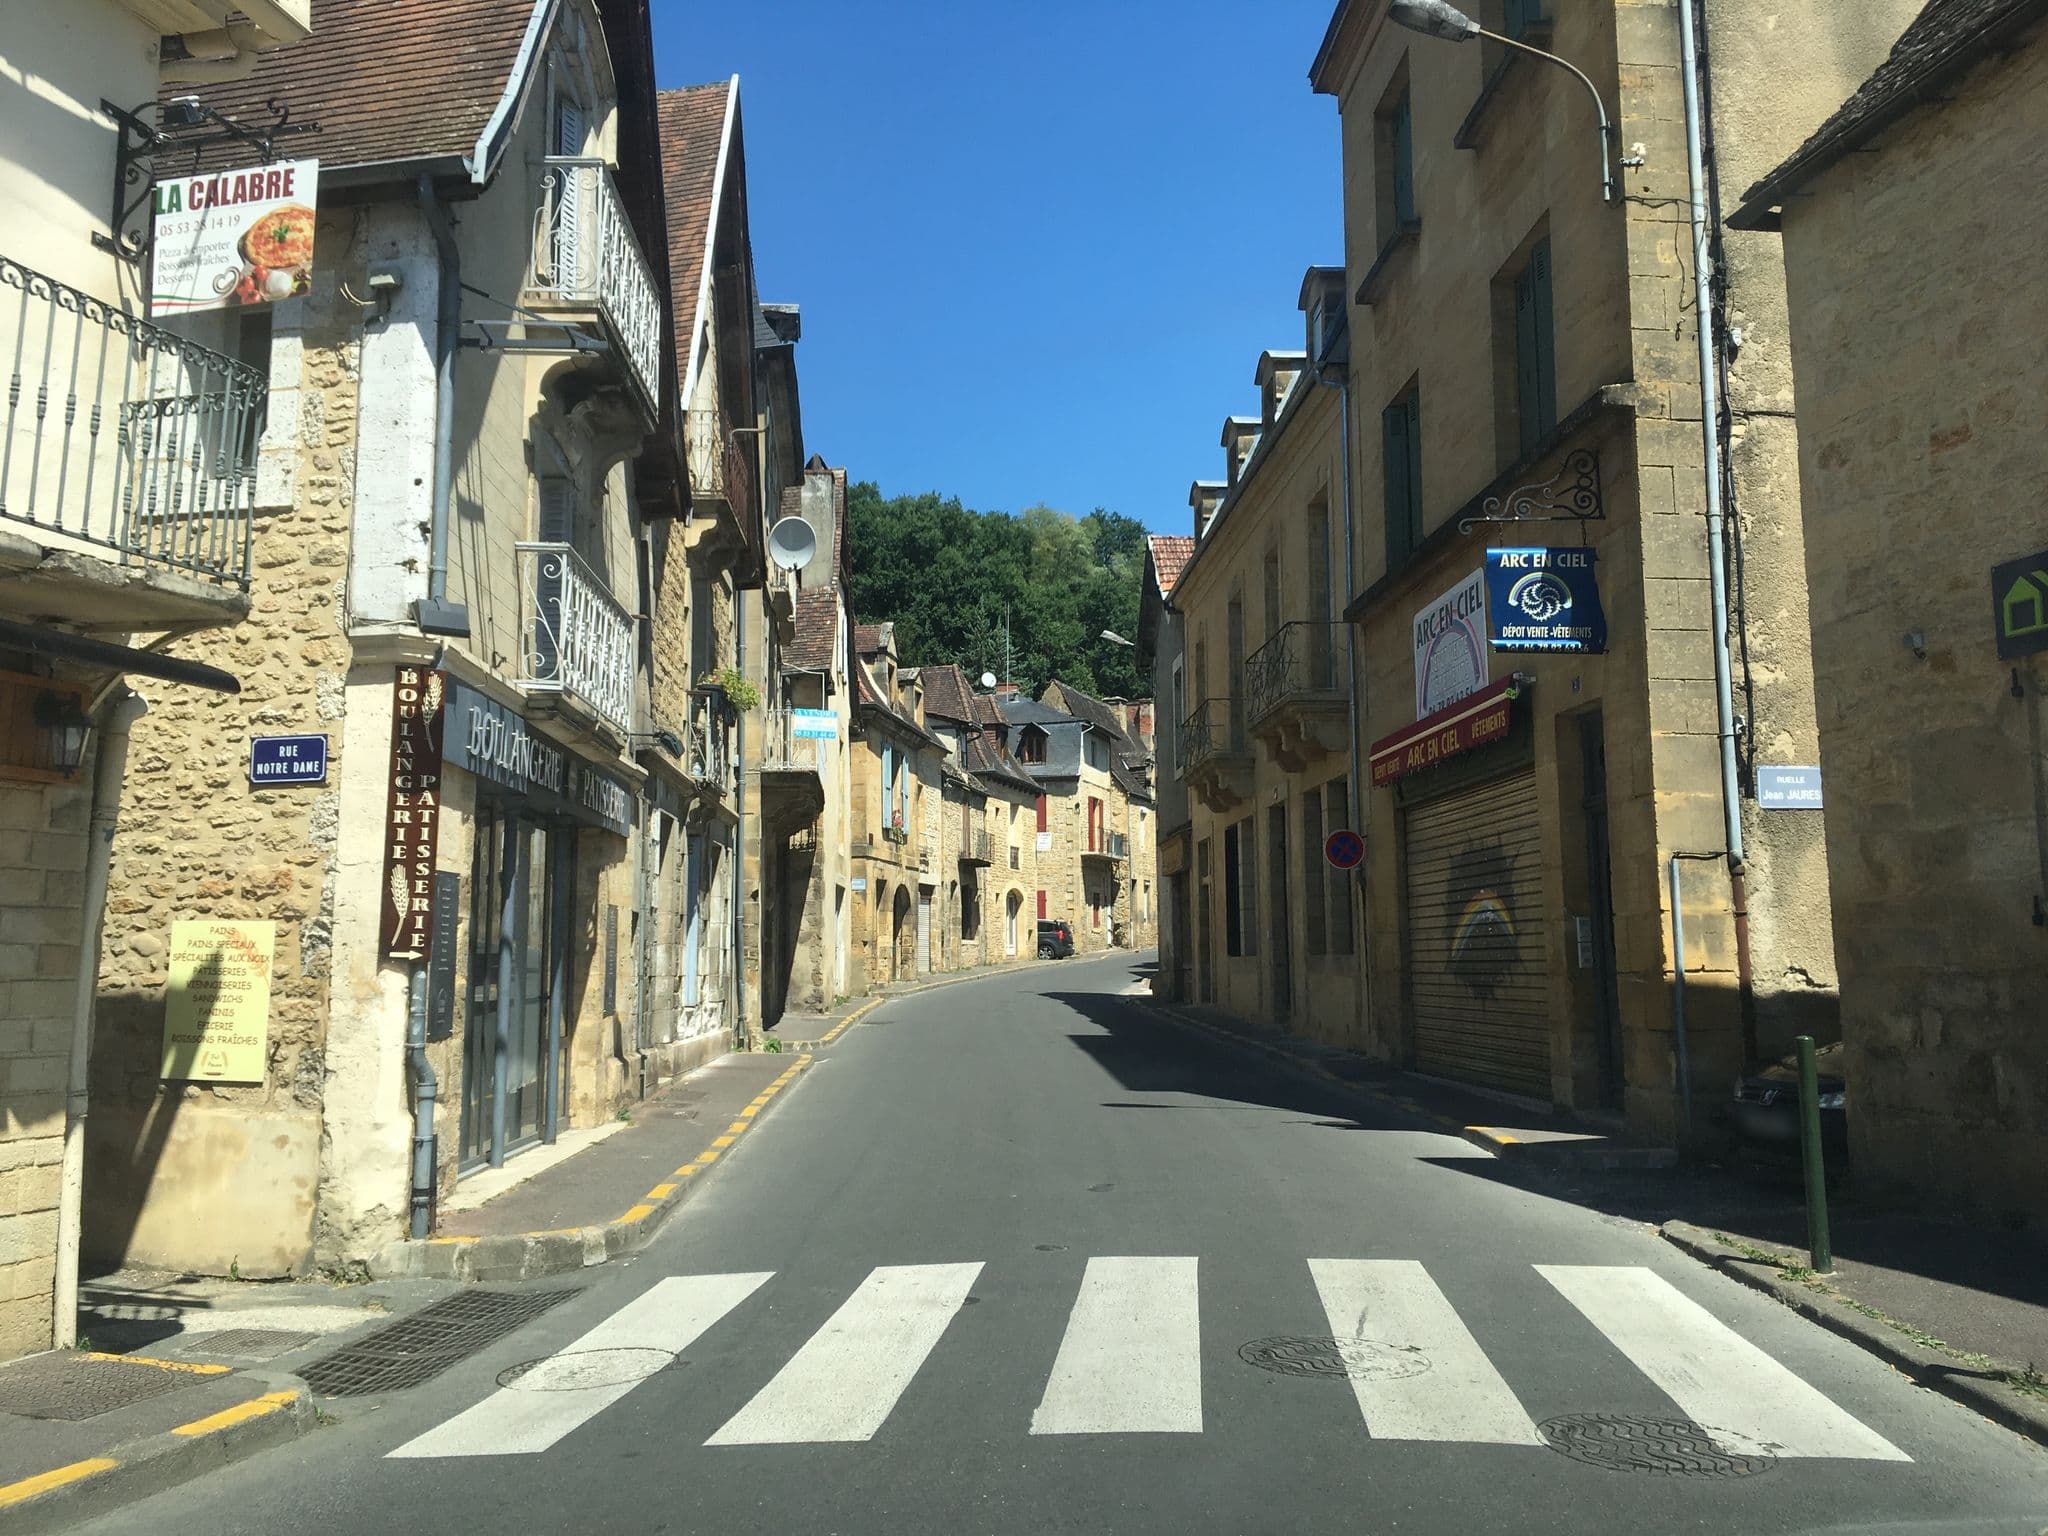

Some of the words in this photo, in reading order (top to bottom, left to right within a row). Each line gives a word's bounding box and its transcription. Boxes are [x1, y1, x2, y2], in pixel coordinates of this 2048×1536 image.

[156, 184, 182, 215] LA
[188, 168, 295, 211] CALABRE
[159, 222, 173, 237] 05
[176, 219, 190, 234] 53
[211, 216, 223, 230] 14
[228, 214, 241, 228] 19
[159, 248, 181, 259] Pizza
[190, 241, 231, 255] emporter
[158, 272, 194, 285] Desserts
[1500, 553, 1529, 568] ARC
[1533, 553, 1552, 568] EN
[1557, 553, 1588, 568] CIEL
[1416, 612, 1437, 650] ARC
[1439, 601, 1454, 632] EN
[1457, 581, 1483, 621] CIEL
[1502, 622, 1526, 638] DÉPOT
[1527, 626, 1549, 638] VENTE
[1407, 743, 1425, 769] ARC
[1427, 737, 1439, 761] EN
[1441, 727, 1460, 754] CIEL
[1471, 709, 1506, 739] VÊTEMENTS
[278, 745, 299, 758] RUE
[256, 762, 288, 775] NOTRE
[293, 760, 320, 773] DAME
[391, 669, 418, 860] BOULANGERIE
[469, 704, 564, 793] BOULANGERIE
[583, 768, 626, 824] PATISSERIE
[1776, 775, 1806, 784] RUELLE
[1763, 789, 1784, 800] Jean
[410, 774, 437, 949] PATISSERIE
[209, 926, 237, 936] PAINS
[187, 939, 214, 949] PAINS
[228, 953, 246, 962] AUX
[246, 954, 271, 964] NOIX
[186, 980, 252, 990] VIENNOISERIES
[192, 994, 244, 1004] SANDWICHS
[198, 1007, 235, 1017] PANINIS
[171, 1033, 215, 1044] BOISSONS
[217, 1032, 259, 1046] FRAÎCHES
